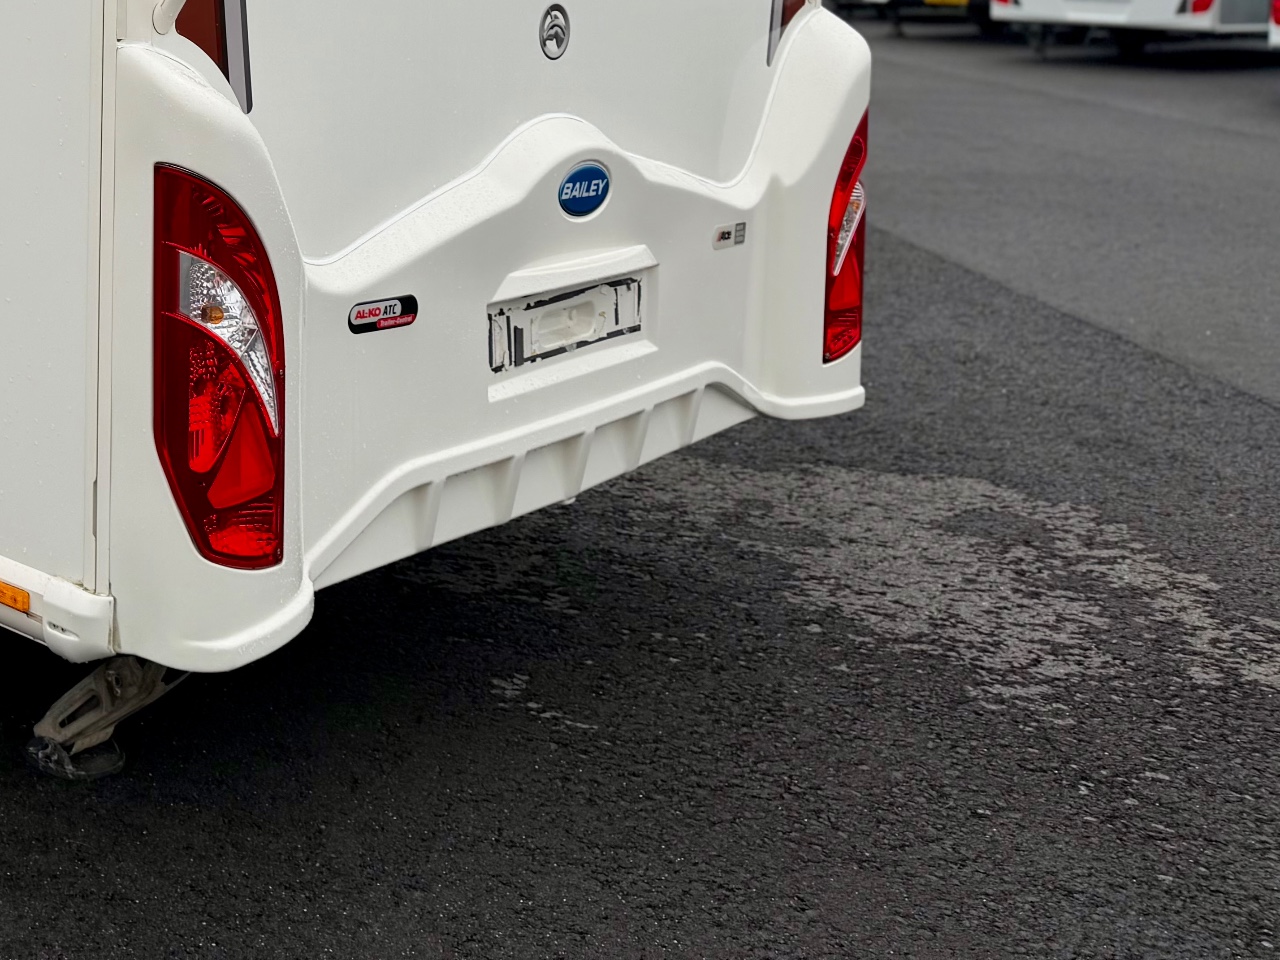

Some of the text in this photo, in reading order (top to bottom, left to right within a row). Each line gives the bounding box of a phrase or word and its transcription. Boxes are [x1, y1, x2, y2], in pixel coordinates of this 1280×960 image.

[561, 178, 608, 200] BAILEY
[355, 303, 398, 320] AL-KO ATC
